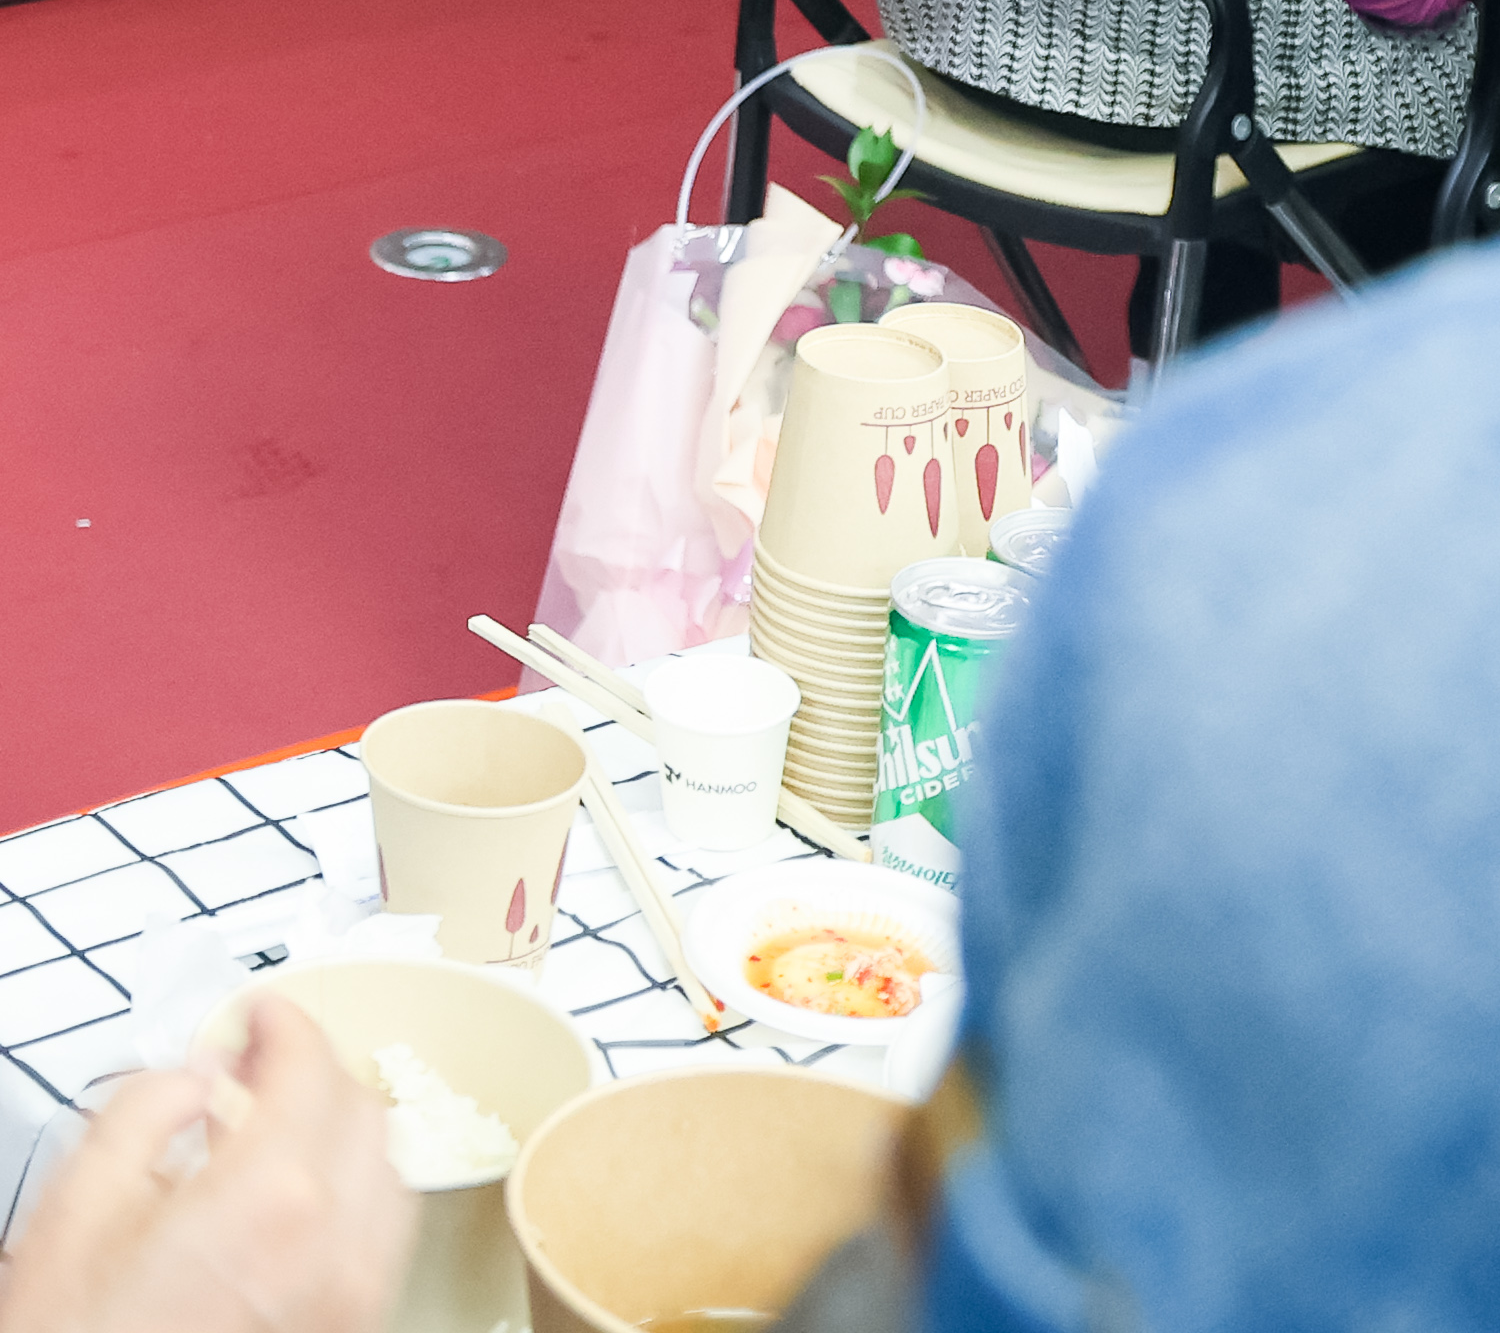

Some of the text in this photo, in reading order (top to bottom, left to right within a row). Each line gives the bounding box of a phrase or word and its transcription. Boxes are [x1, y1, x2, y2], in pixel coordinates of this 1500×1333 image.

[965, 385, 1007, 404] PAPER
[873, 406, 907, 421] CUP
[685, 777, 758, 795] HANMOO
